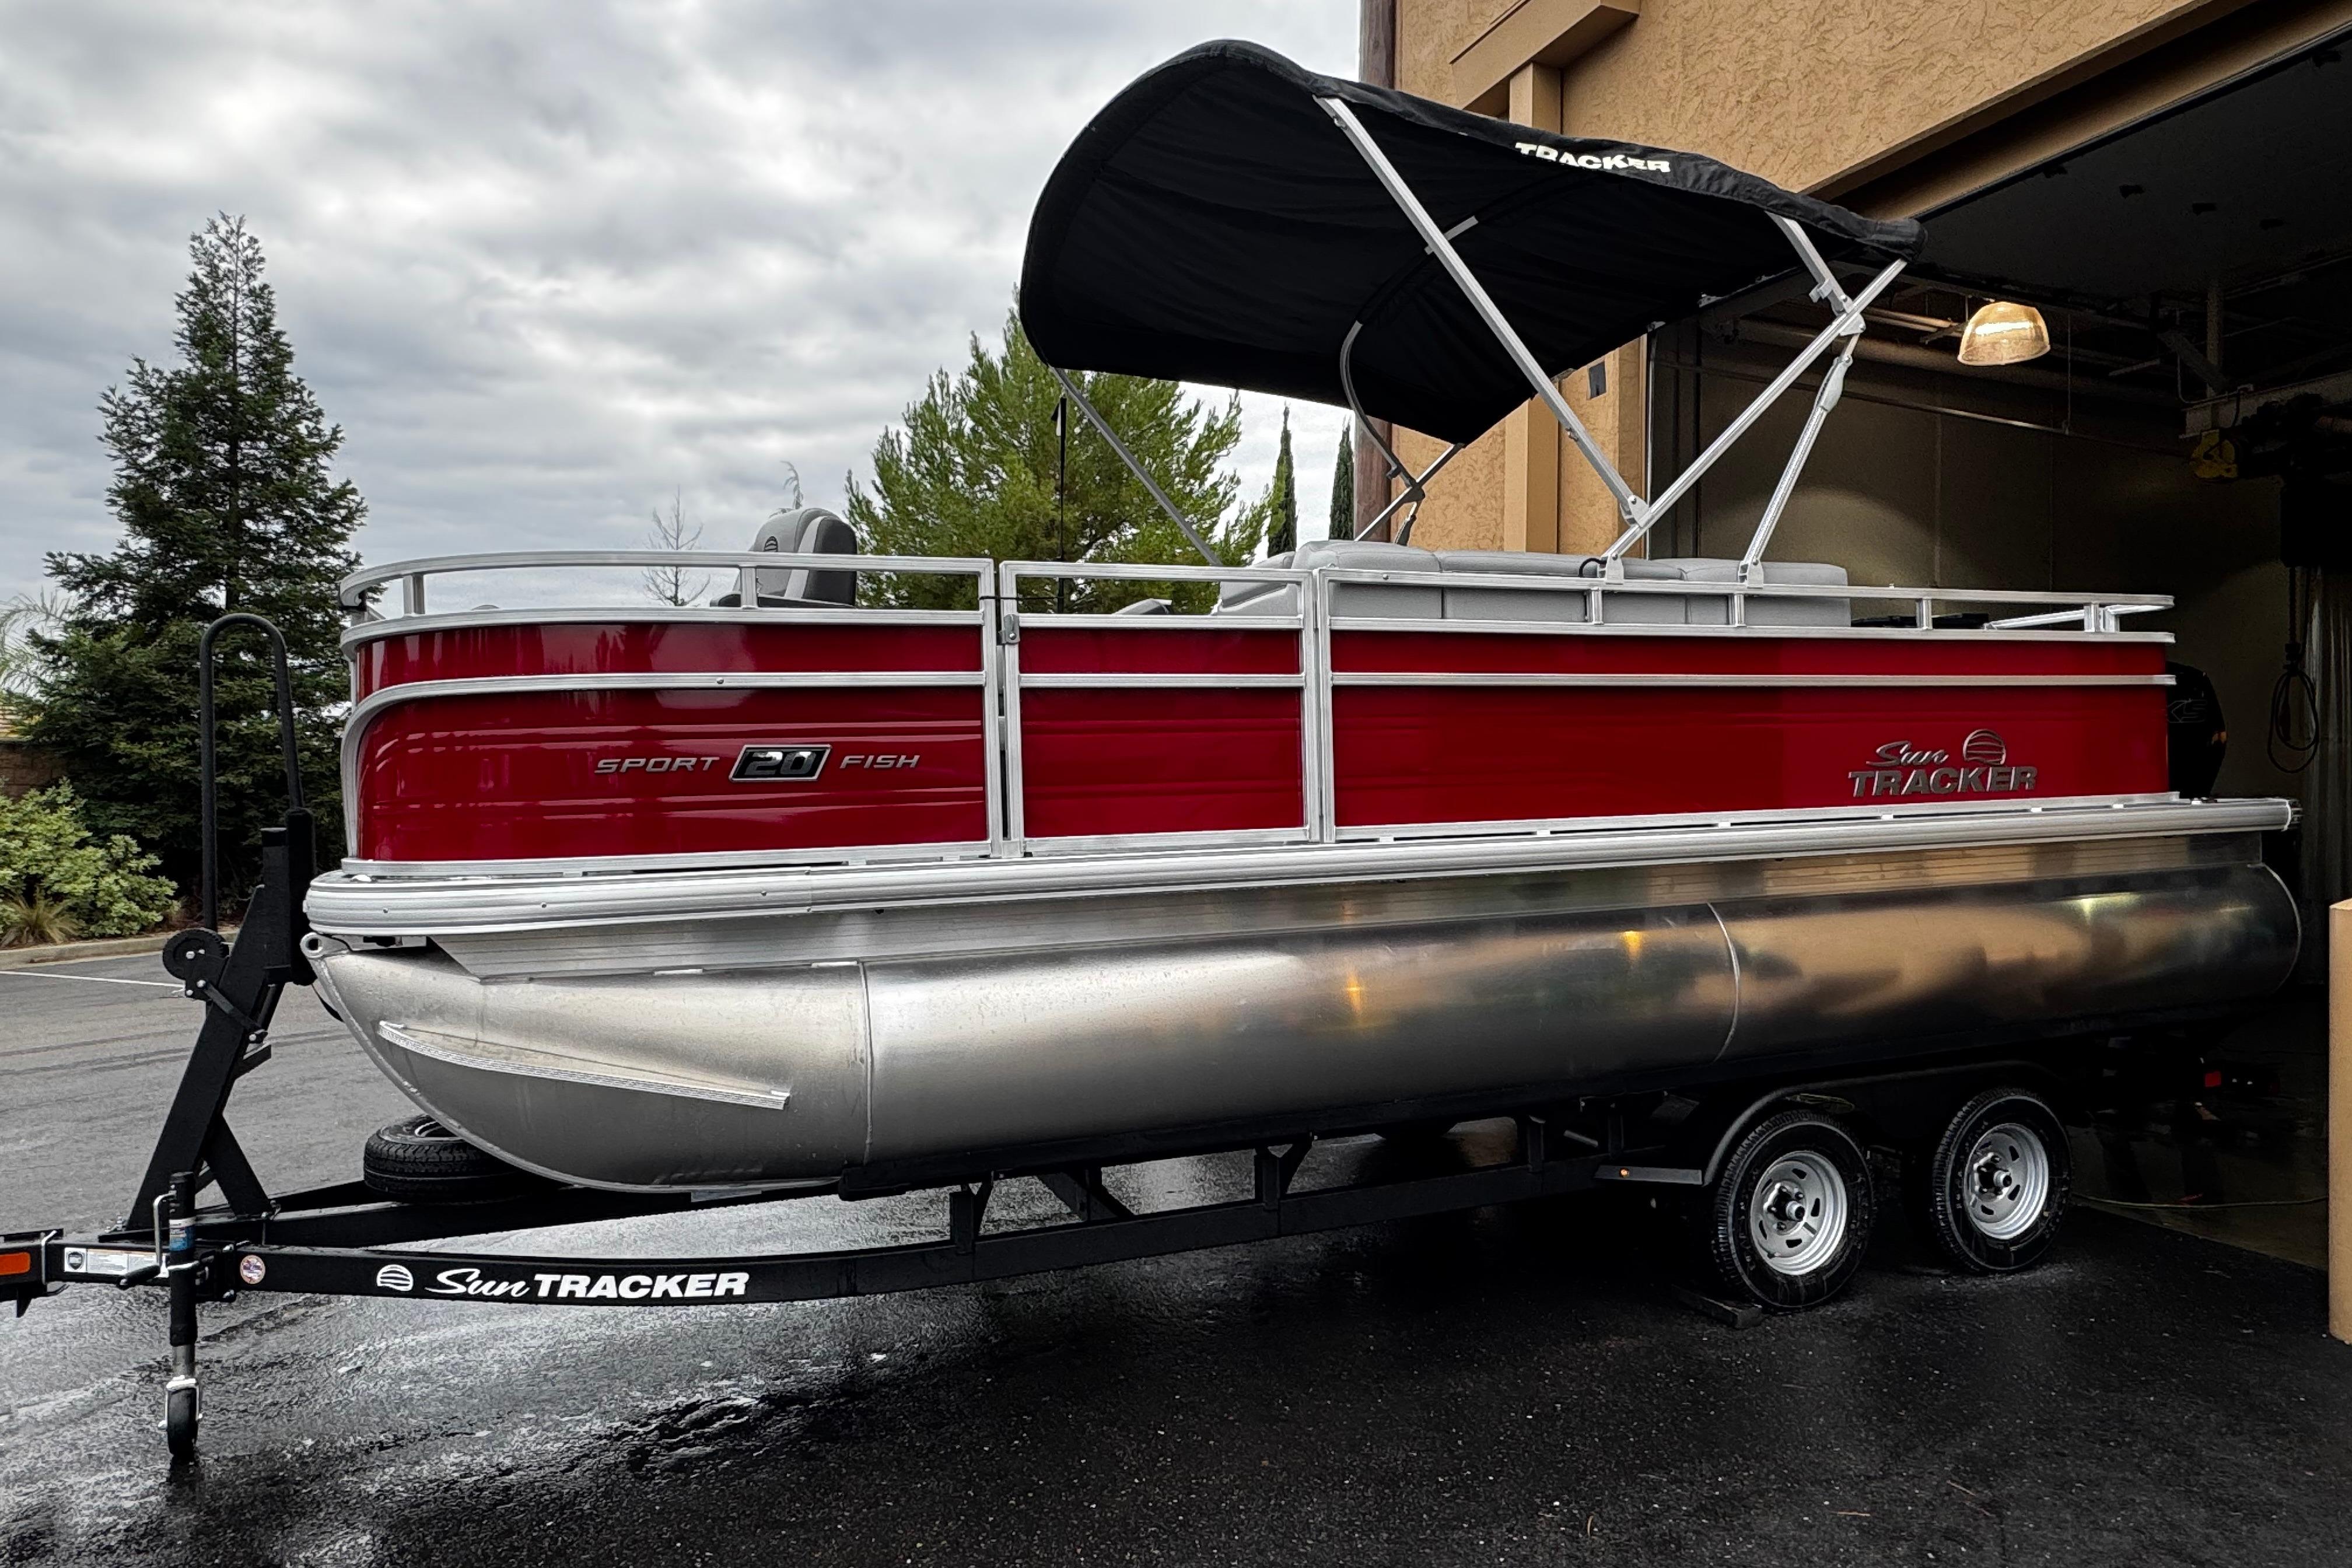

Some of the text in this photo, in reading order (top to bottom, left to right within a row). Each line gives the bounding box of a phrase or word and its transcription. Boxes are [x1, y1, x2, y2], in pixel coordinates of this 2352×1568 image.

[594, 750, 921, 776] SPORT 20 FISH
[1866, 740, 1950, 767] Sun
[1848, 766, 2038, 797] TRACKER
[424, 1268, 750, 1298] Sun TRACKER
